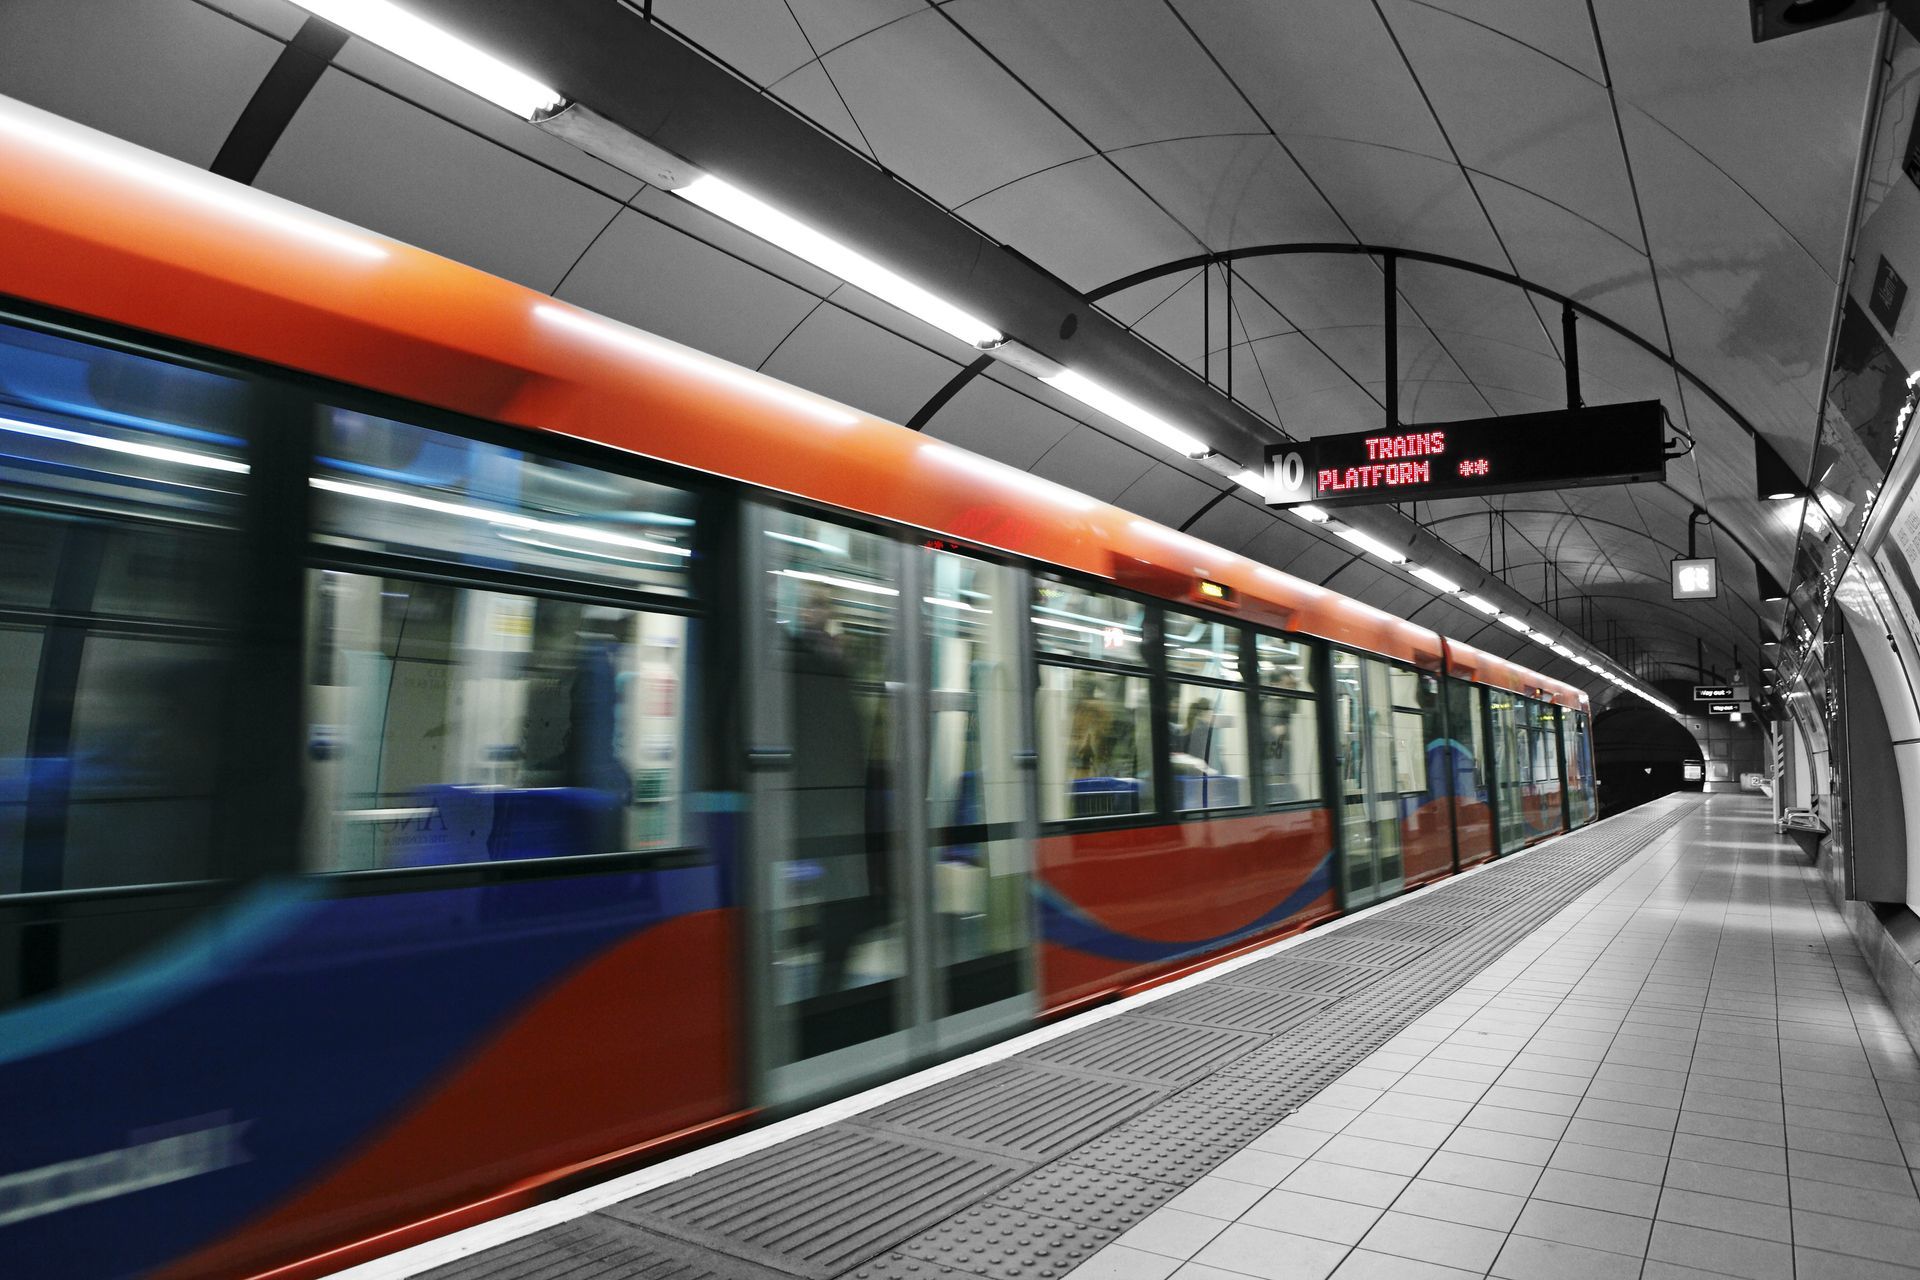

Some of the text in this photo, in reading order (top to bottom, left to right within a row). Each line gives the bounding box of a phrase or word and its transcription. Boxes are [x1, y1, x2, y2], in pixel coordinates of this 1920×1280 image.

[1364, 432, 1444, 460] TRAINS
[1272, 452, 1304, 491] 10
[1318, 460, 1430, 491] PLATFORM
